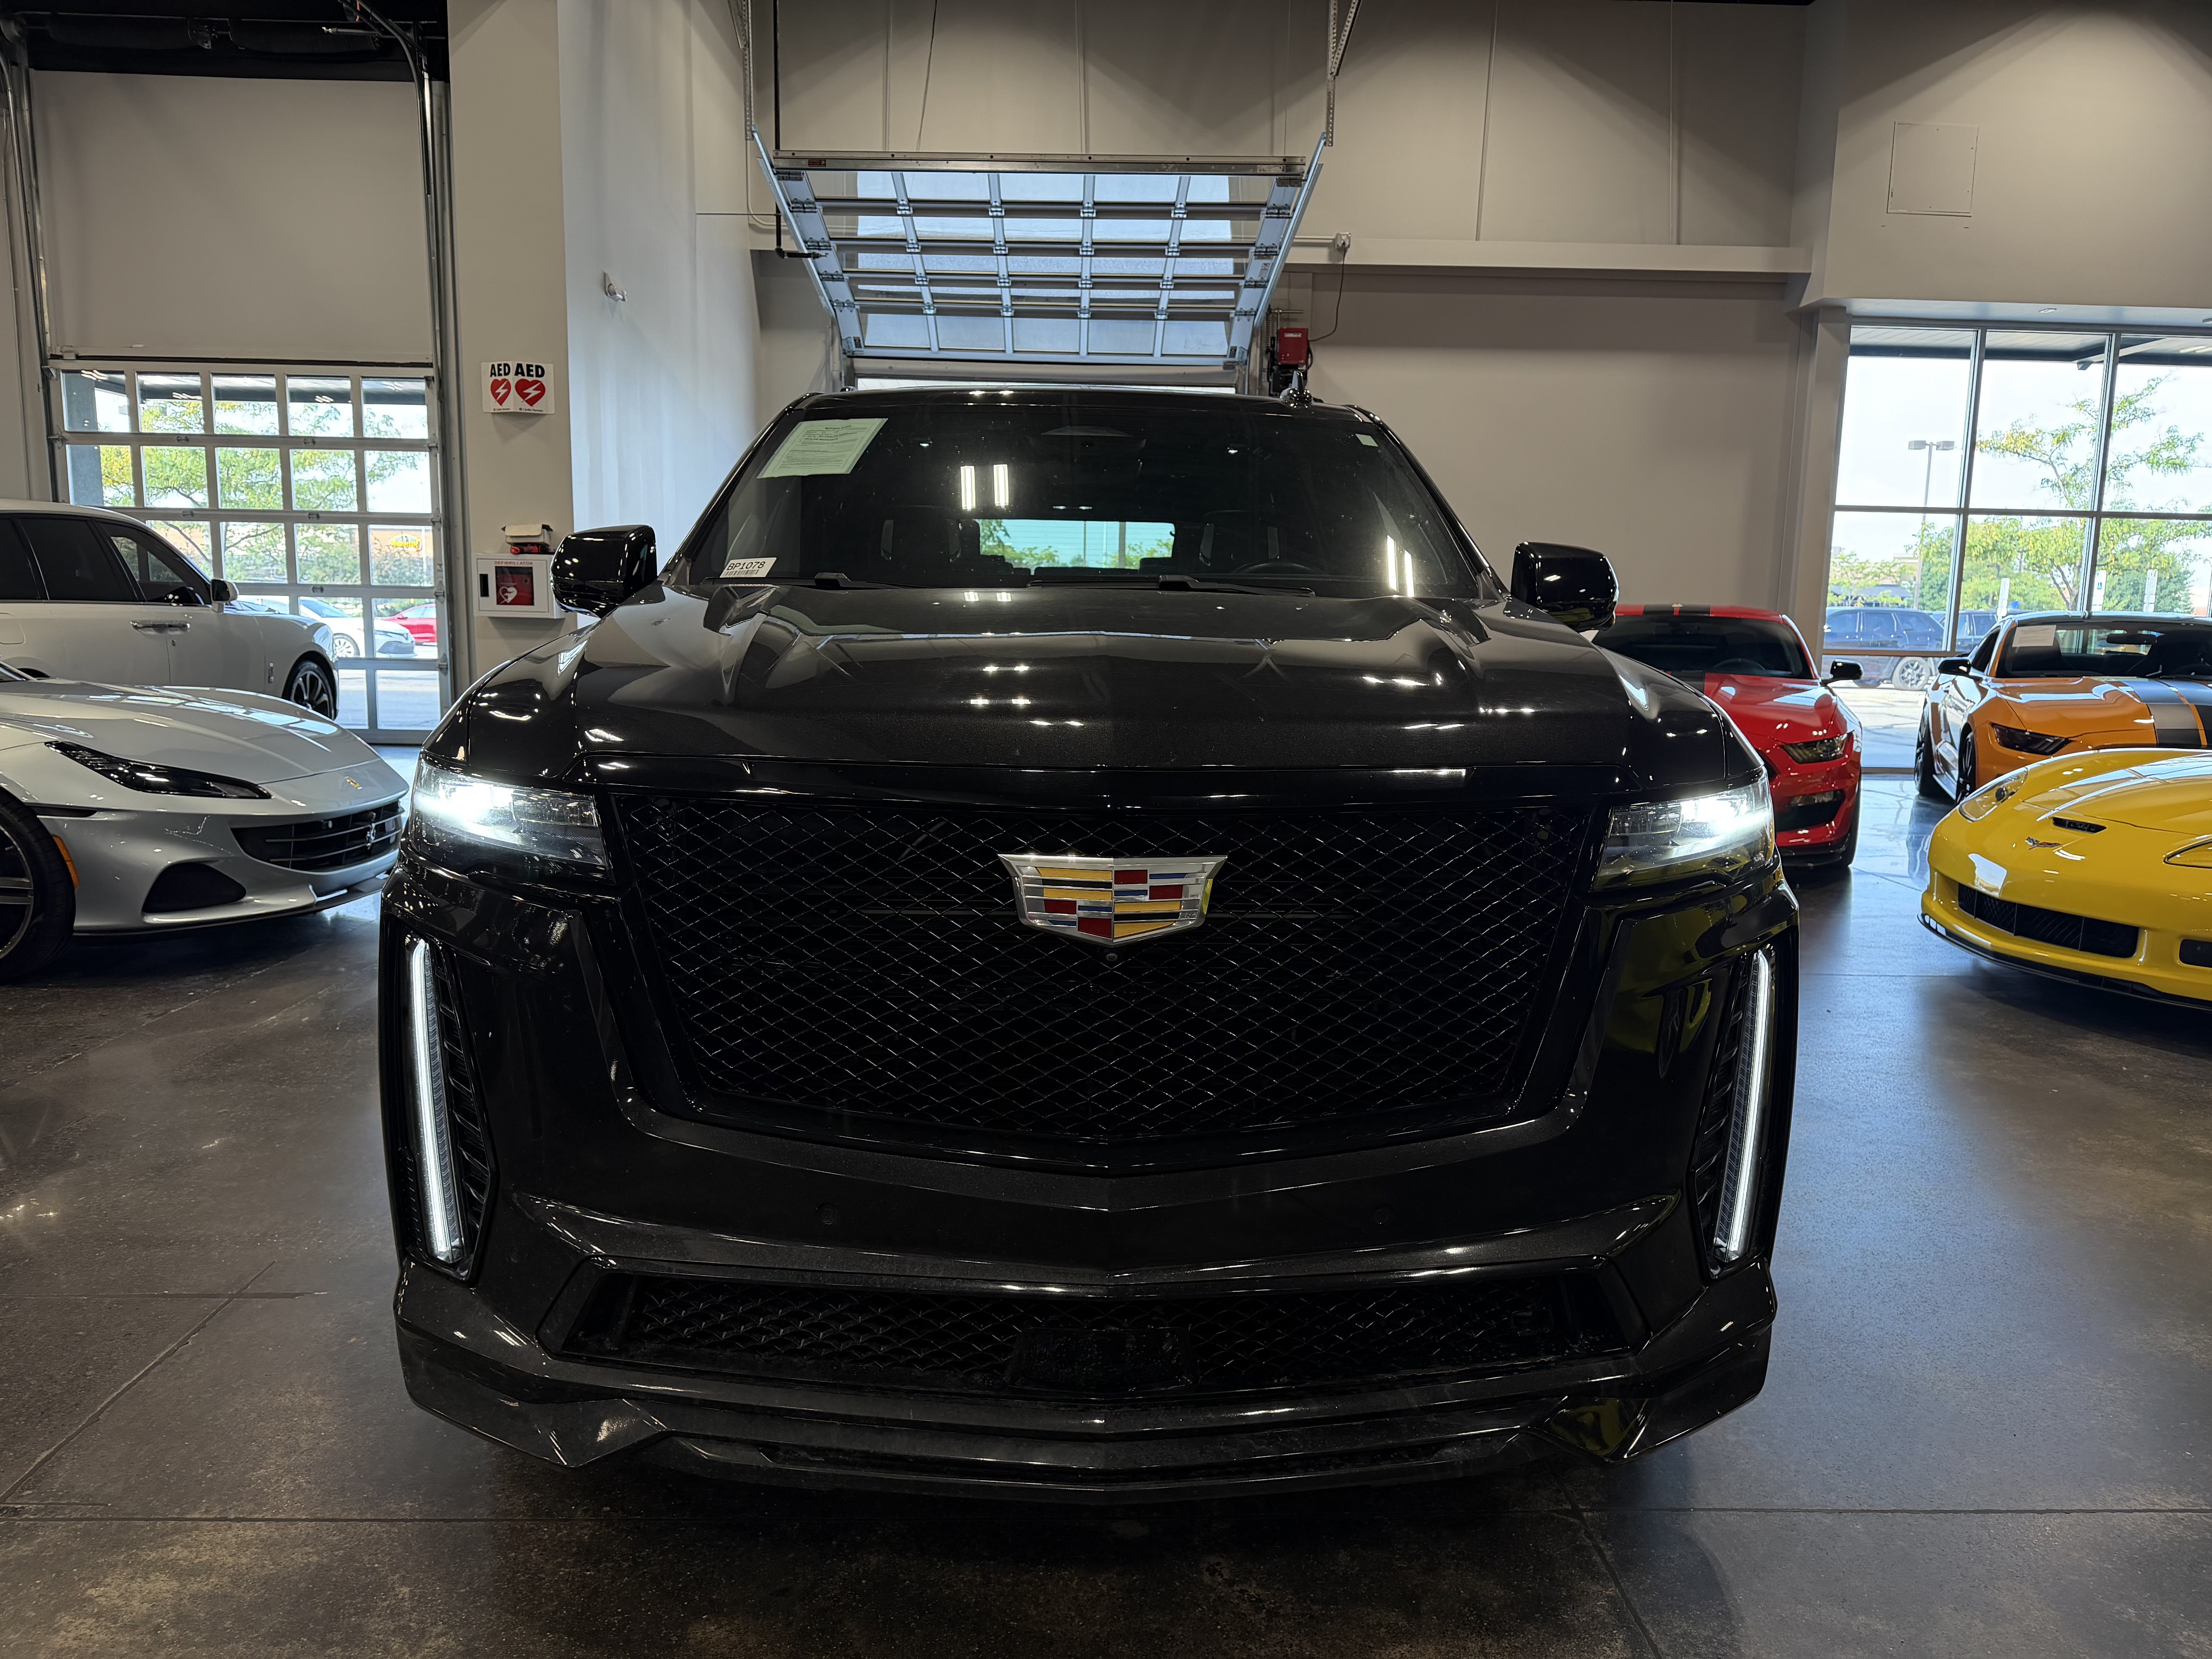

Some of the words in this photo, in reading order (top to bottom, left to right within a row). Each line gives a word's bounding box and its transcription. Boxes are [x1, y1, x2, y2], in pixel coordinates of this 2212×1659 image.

[490, 363, 510, 377] AED
[514, 363, 545, 378] AED
[726, 561, 766, 570] BP1078
